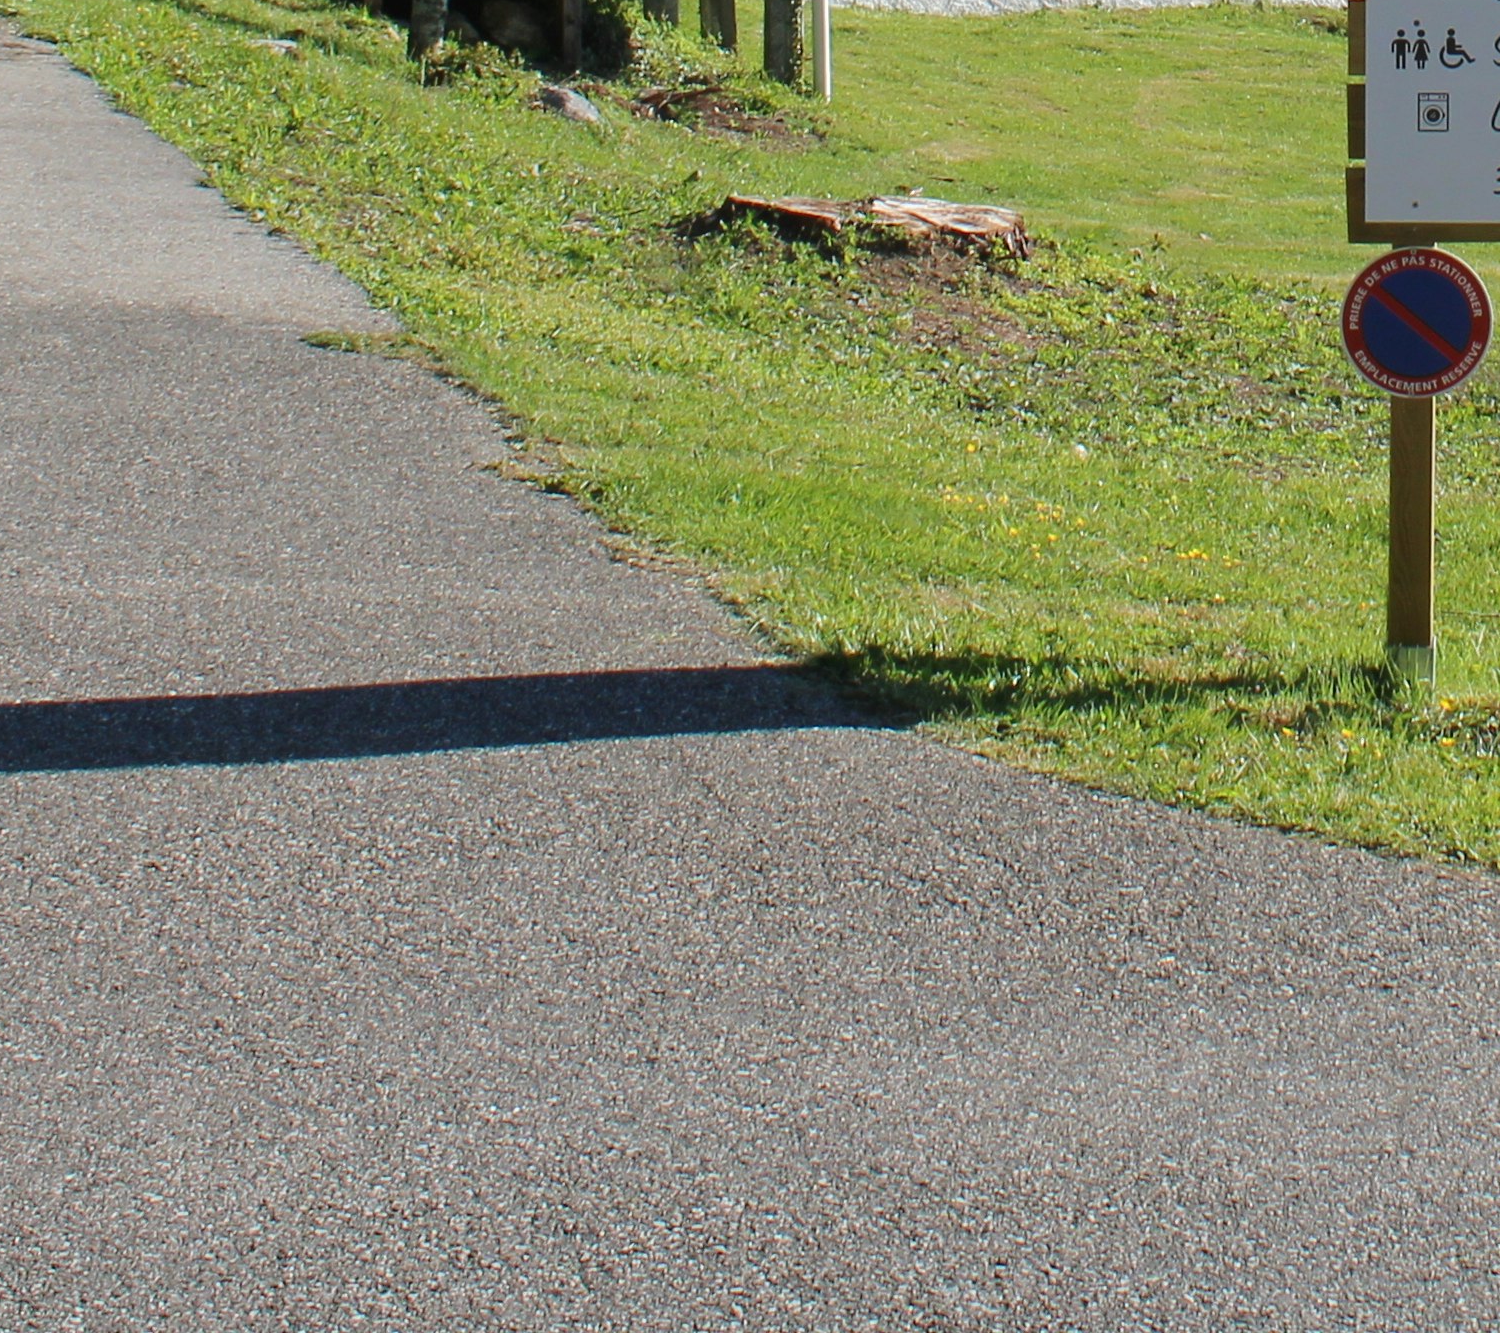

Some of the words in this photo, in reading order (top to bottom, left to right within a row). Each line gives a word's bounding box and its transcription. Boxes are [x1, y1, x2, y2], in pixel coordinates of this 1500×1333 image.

[1349, 287, 1368, 331] PRIERE
[1364, 270, 1381, 288] DE
[1381, 259, 1399, 275] NE
[1401, 255, 1426, 268] PAS
[1429, 258, 1483, 318] STATIONNER
[1354, 349, 1439, 392] EMPLACEMENT
[1441, 340, 1483, 385] RESERVE
